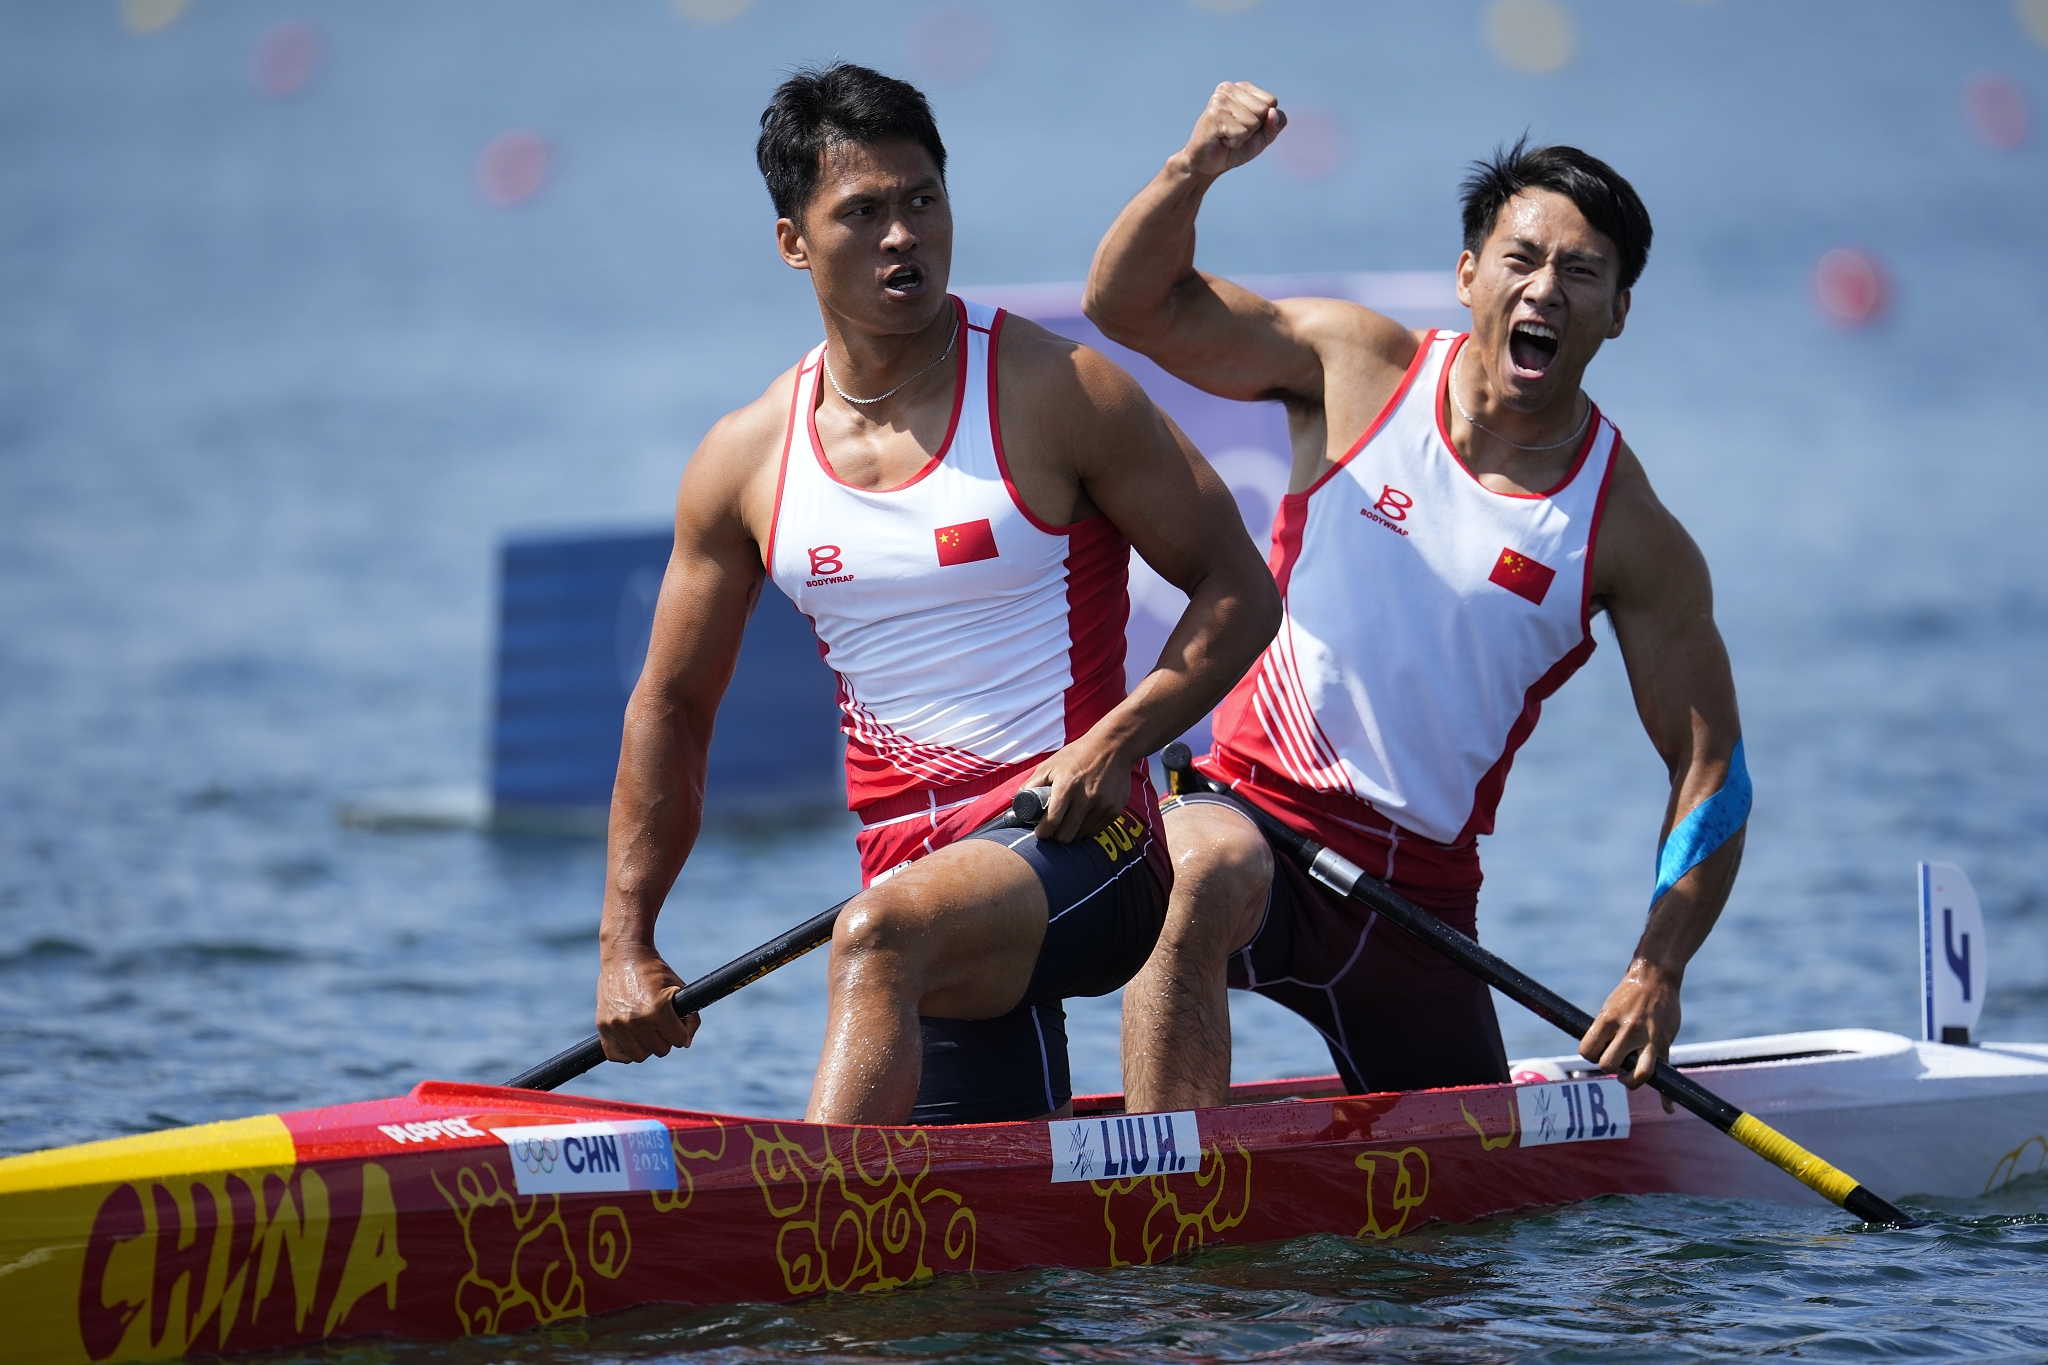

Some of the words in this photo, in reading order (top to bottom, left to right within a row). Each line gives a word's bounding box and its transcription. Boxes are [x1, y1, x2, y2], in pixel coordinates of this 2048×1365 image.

[1360, 508, 1409, 537] BODYWRAP
[806, 574, 855, 588] BODYWRAP
[1943, 908, 1972, 1003] 4
[1561, 1084, 1585, 1140] JI
[1587, 1083, 1617, 1137] B.
[563, 1134, 621, 1174] CHN
[628, 1132, 665, 1150] PARIS
[1100, 1117, 1150, 1176] LIU
[1153, 1115, 1185, 1172] H.
[632, 1153, 669, 1172] 2024
[78, 1163, 408, 1362] CHINA
